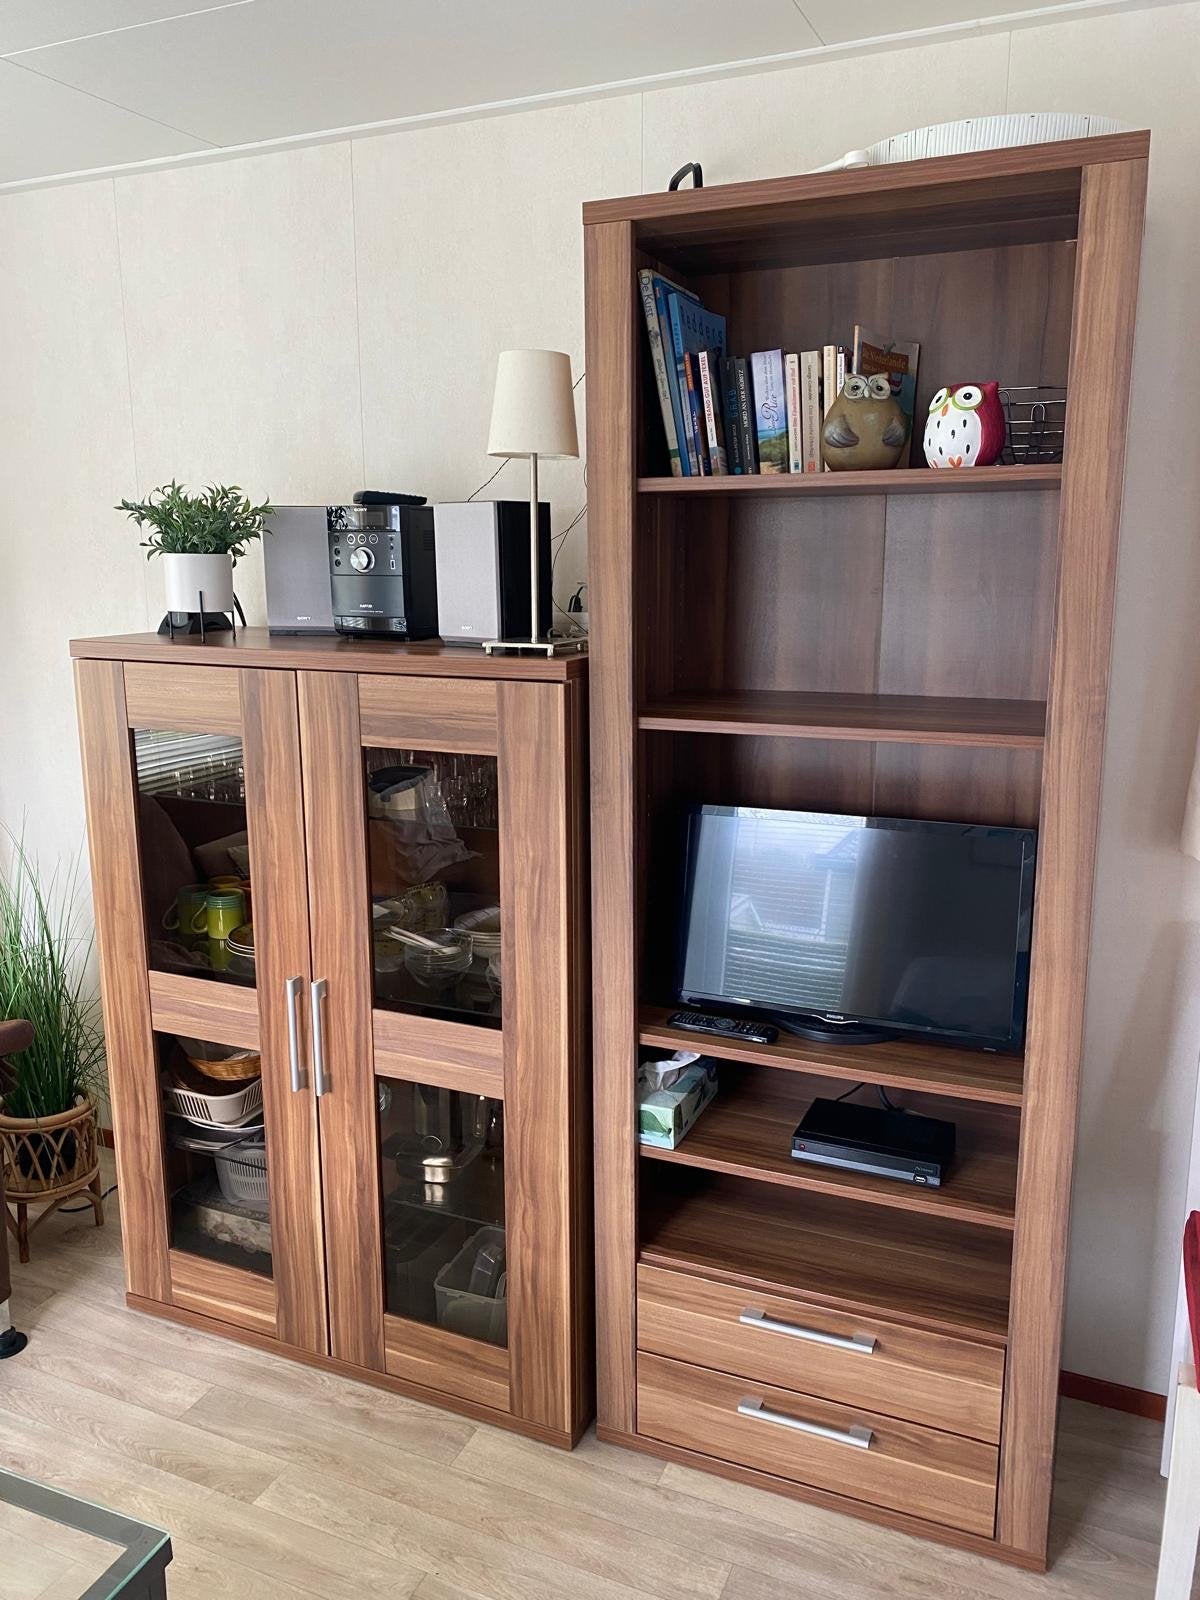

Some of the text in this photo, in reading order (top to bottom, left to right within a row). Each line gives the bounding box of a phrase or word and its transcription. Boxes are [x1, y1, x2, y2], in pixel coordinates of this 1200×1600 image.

[640, 275, 655, 319] De Kust
[700, 355, 708, 373] TEXEL
[705, 400, 713, 423] STRAND
